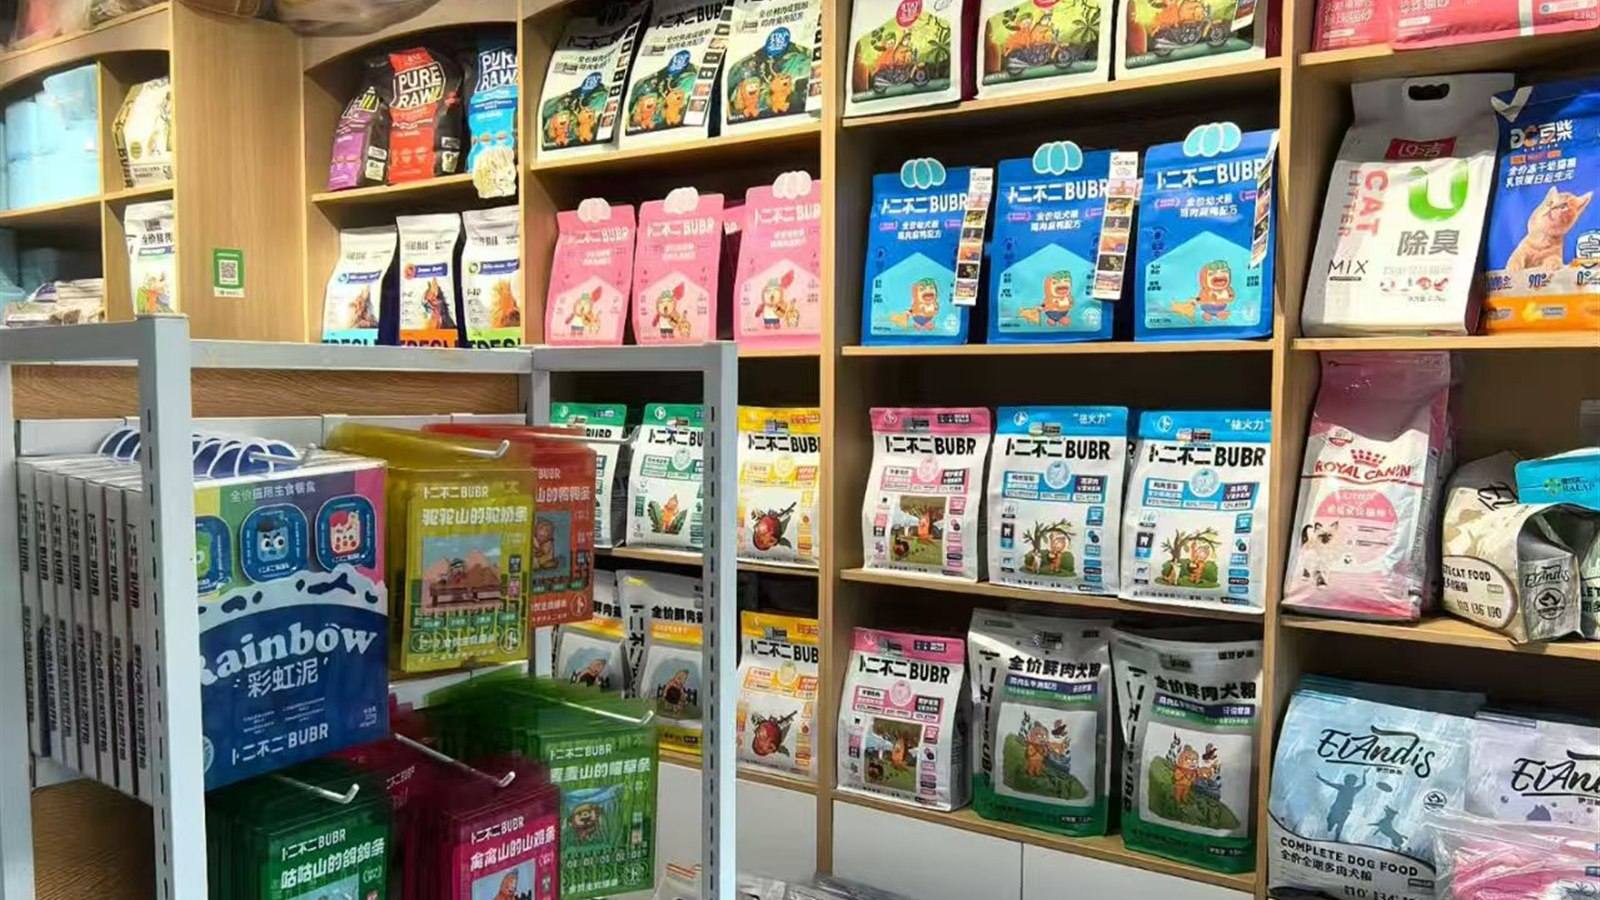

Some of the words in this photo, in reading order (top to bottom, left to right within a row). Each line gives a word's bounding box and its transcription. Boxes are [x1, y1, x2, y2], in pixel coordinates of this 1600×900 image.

[399, 66, 442, 91] PURE
[398, 86, 441, 108] RAW
[1337, 170, 1361, 237] LITTER
[1356, 170, 1389, 236] CAT
[1397, 229, 1461, 256] 除臭
[886, 435, 976, 455] 卜二不二BUBR
[1005, 438, 1110, 460] 卜二不二BUBR
[1150, 443, 1266, 467] 卜二不二BUBR
[1314, 460, 1362, 481] ROYAL
[423, 486, 489, 500] 卜二不二BUBR
[1468, 569, 1492, 583] FOOD
[248, 657, 319, 698] 彩虹泥
[859, 655, 950, 684] 卜二不二BUBR
[1008, 655, 1101, 680] 全价鲜肉犬粮
[1154, 675, 1256, 702] 全价鲜肉犬粮
[232, 723, 329, 766] 卜二不二BUBR
[550, 744, 612, 761] 卜二不二BUBR
[471, 815, 525, 844] 卜二不二BUBR
[282, 829, 346, 861] 卜二不二BUBR
[1280, 836, 1343, 863] COMPLETE
[1347, 854, 1376, 871] DOG
[1380, 861, 1418, 877] FOOD
